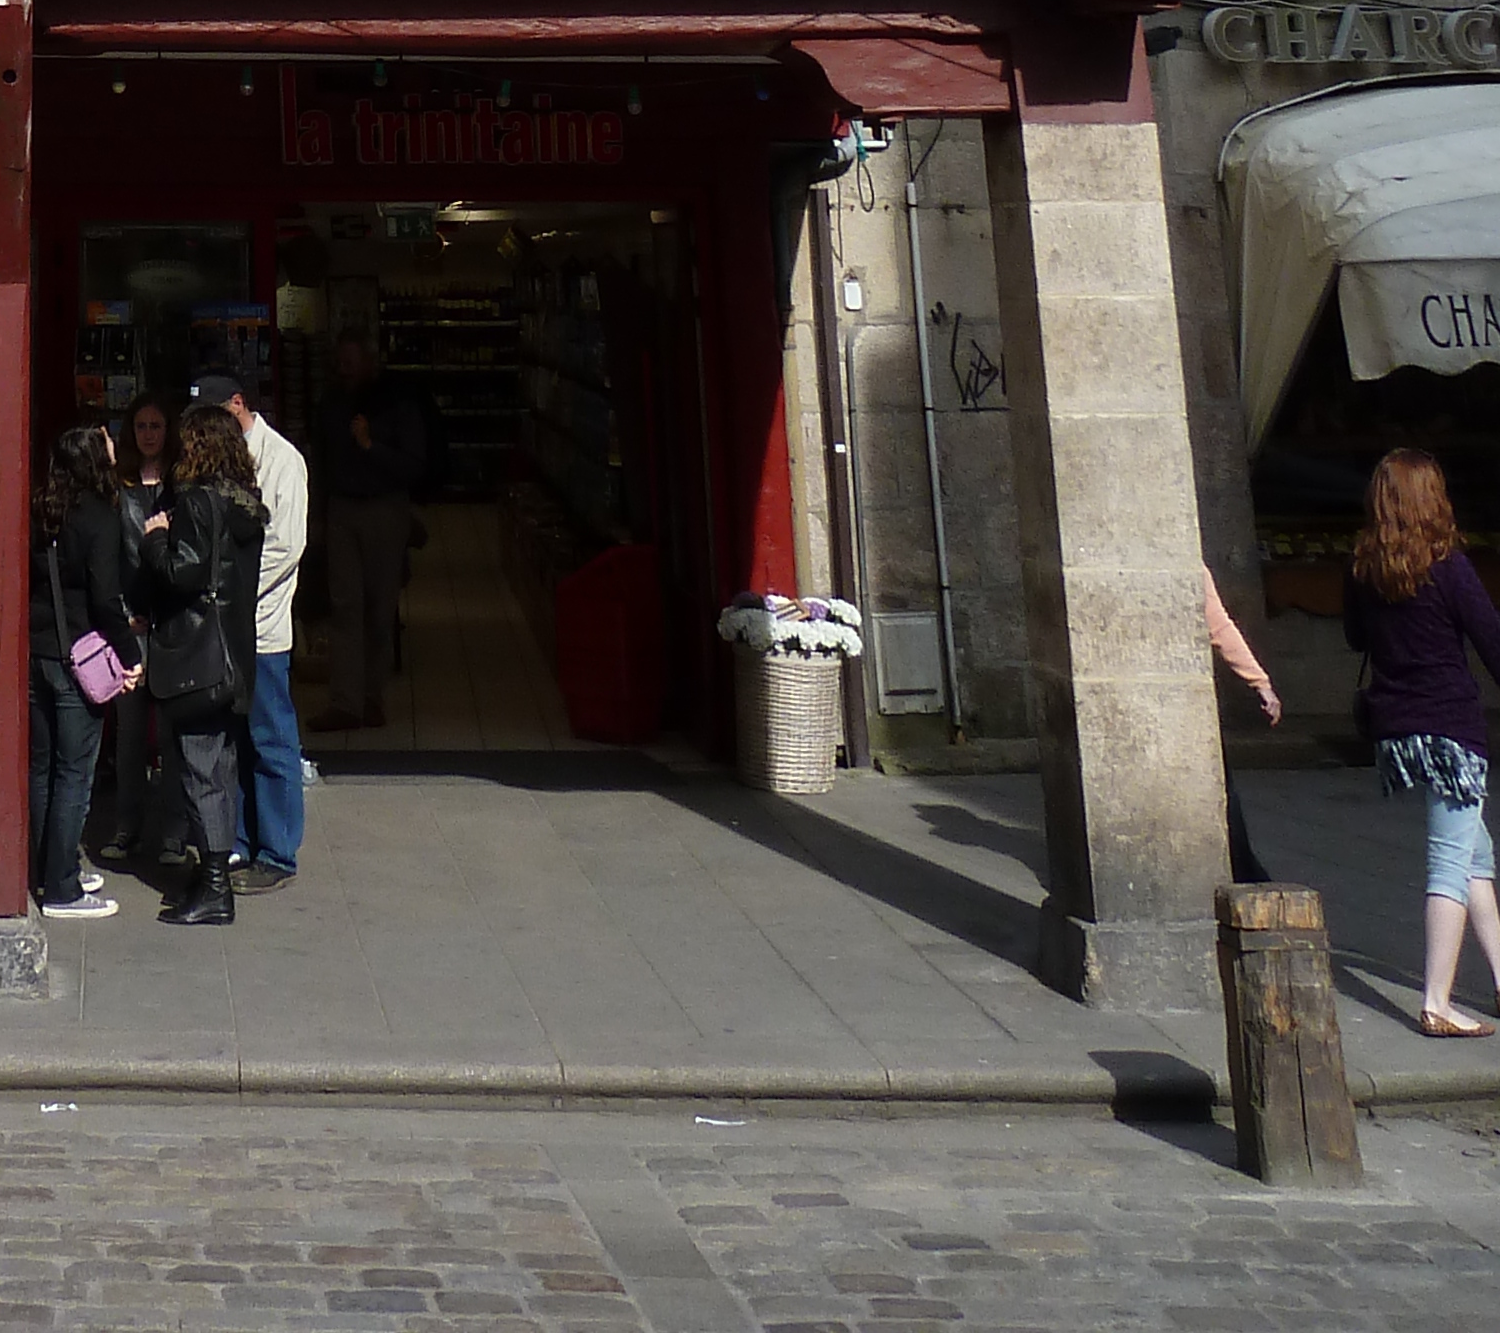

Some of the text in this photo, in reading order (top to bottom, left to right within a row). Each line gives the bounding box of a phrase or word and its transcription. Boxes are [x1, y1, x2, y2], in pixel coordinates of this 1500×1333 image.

[1202, 4, 1499, 65] CHARC
[278, 63, 625, 166] la trinitaine
[1421, 294, 1500, 348] CHA
